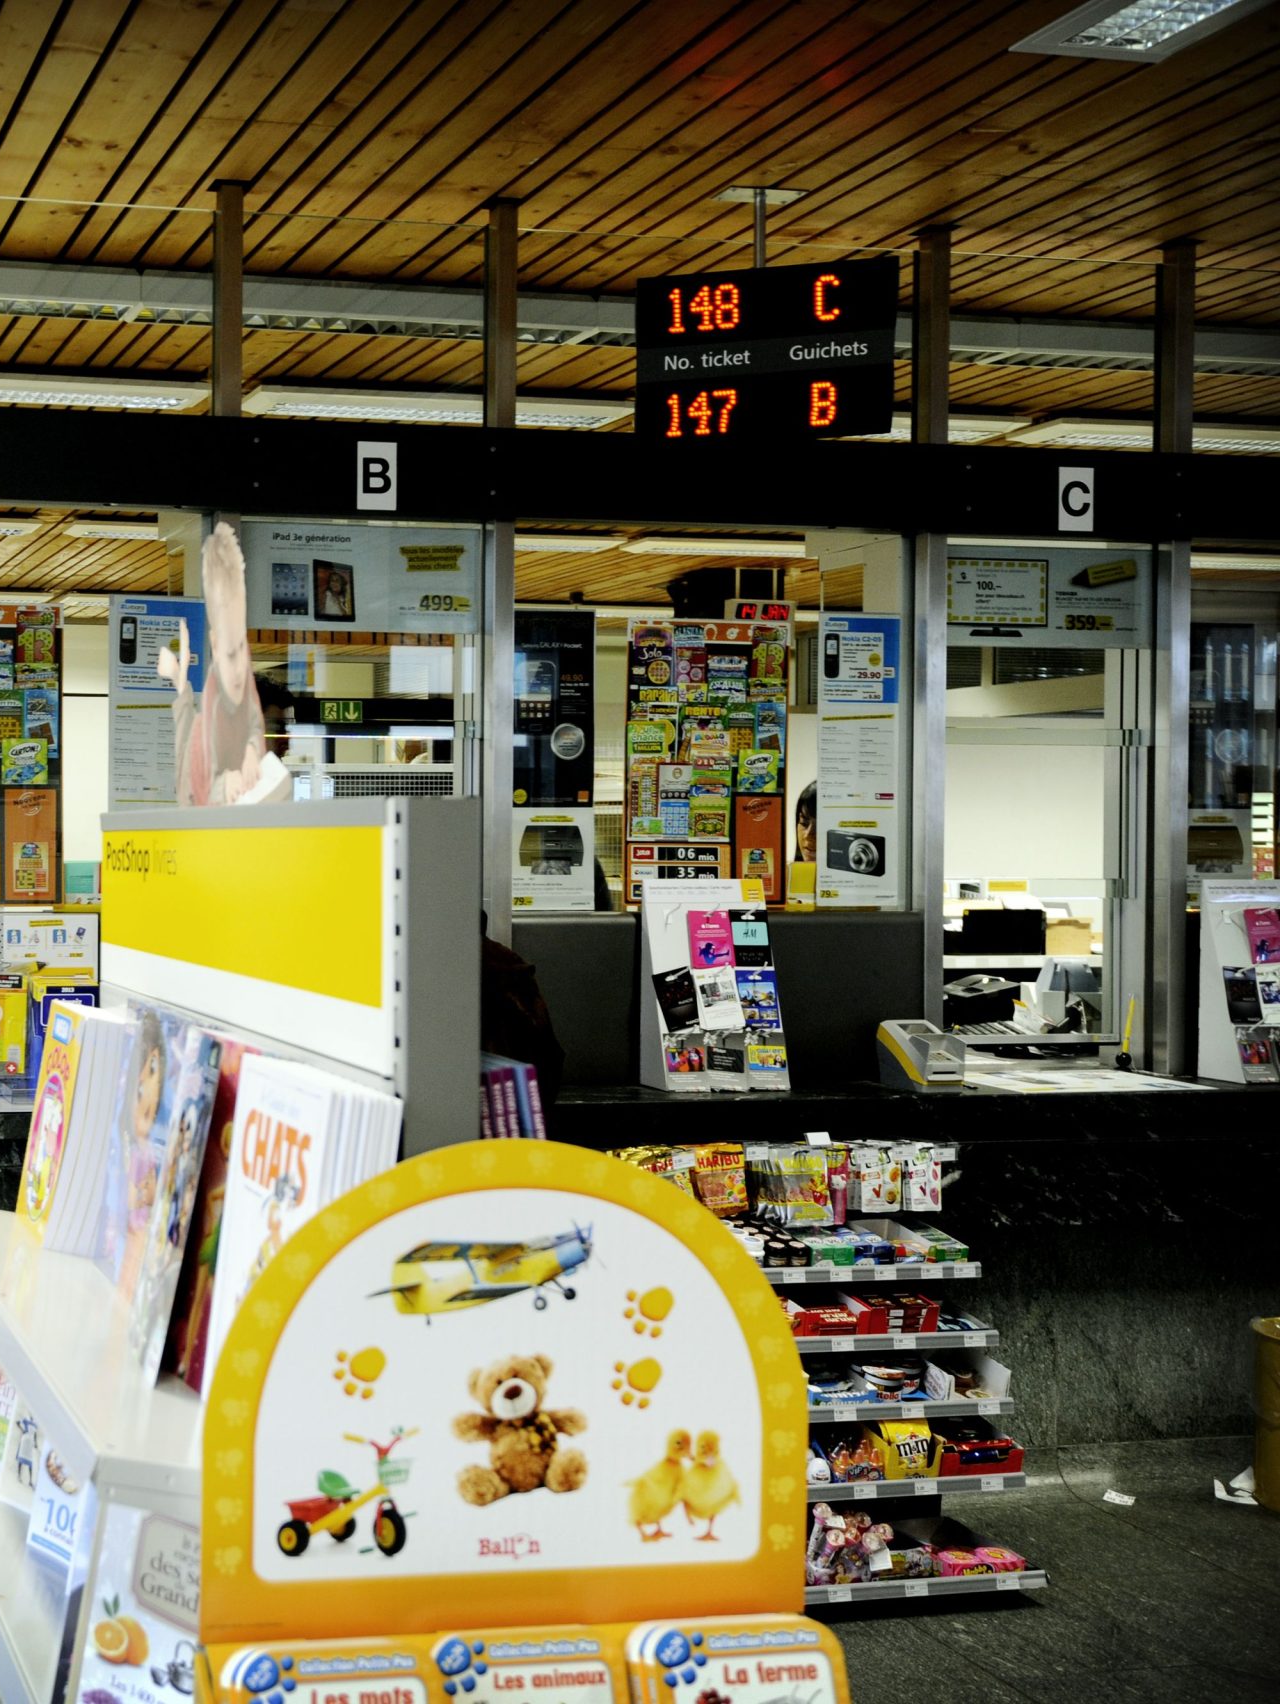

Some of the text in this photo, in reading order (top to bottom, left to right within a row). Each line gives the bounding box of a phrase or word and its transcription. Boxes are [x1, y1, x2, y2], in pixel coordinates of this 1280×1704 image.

[667, 273, 842, 335] 148 C
[664, 350, 752, 371] No. ticket
[789, 341, 869, 362] Guichets
[666, 381, 837, 438] 147 B
[362, 457, 393, 495] B
[1061, 480, 1091, 518] C
[272, 533, 352, 544] iPad 3e génération
[638, 647, 663, 660] Solo
[856, 671, 881, 680] 29.90
[106, 840, 151, 883] PostShop
[241, 1107, 312, 1208] CHATS
[696, 1153, 741, 1169] HARIBO
[493, 1669, 607, 1690] Les animaux
[723, 1660, 818, 1684] La ferme
[359, 1686, 414, 1704] mots
